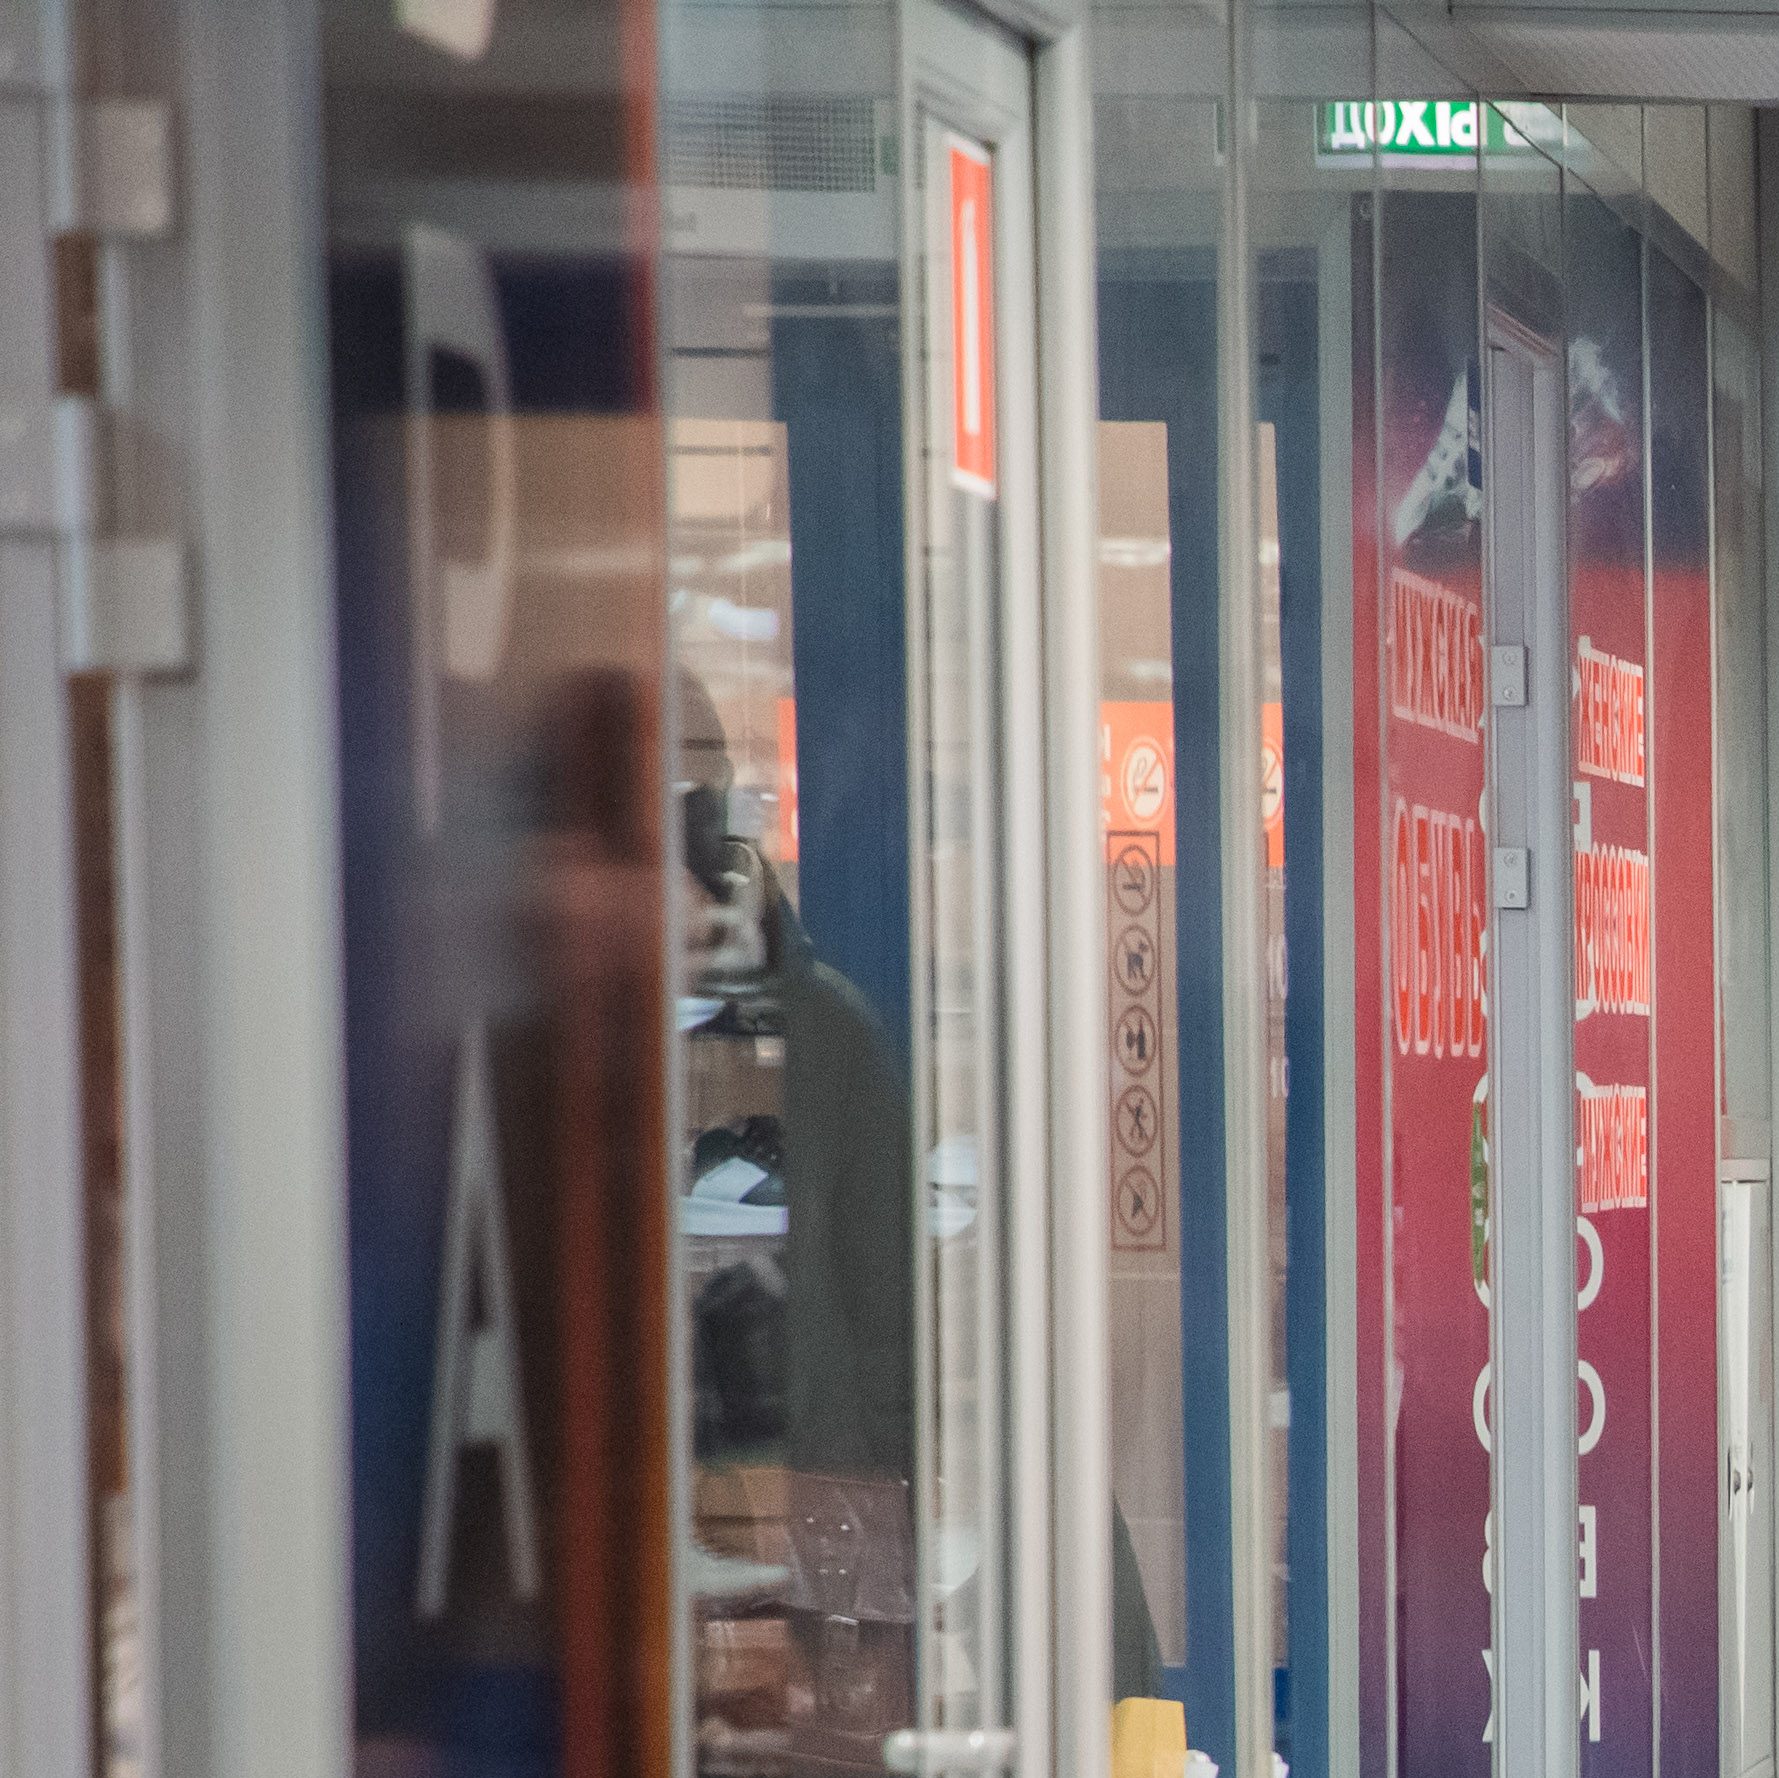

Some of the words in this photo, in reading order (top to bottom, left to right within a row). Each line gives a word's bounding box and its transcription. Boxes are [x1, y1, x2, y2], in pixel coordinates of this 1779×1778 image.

[1578, 647, 1645, 788] ЖЕНСКИЕ
[1391, 796, 1483, 1060] ОБУВЬ
[1574, 841, 1650, 1017] КРОССОВКИ
[1580, 1083, 1647, 1215] МУЖСКИЕ
